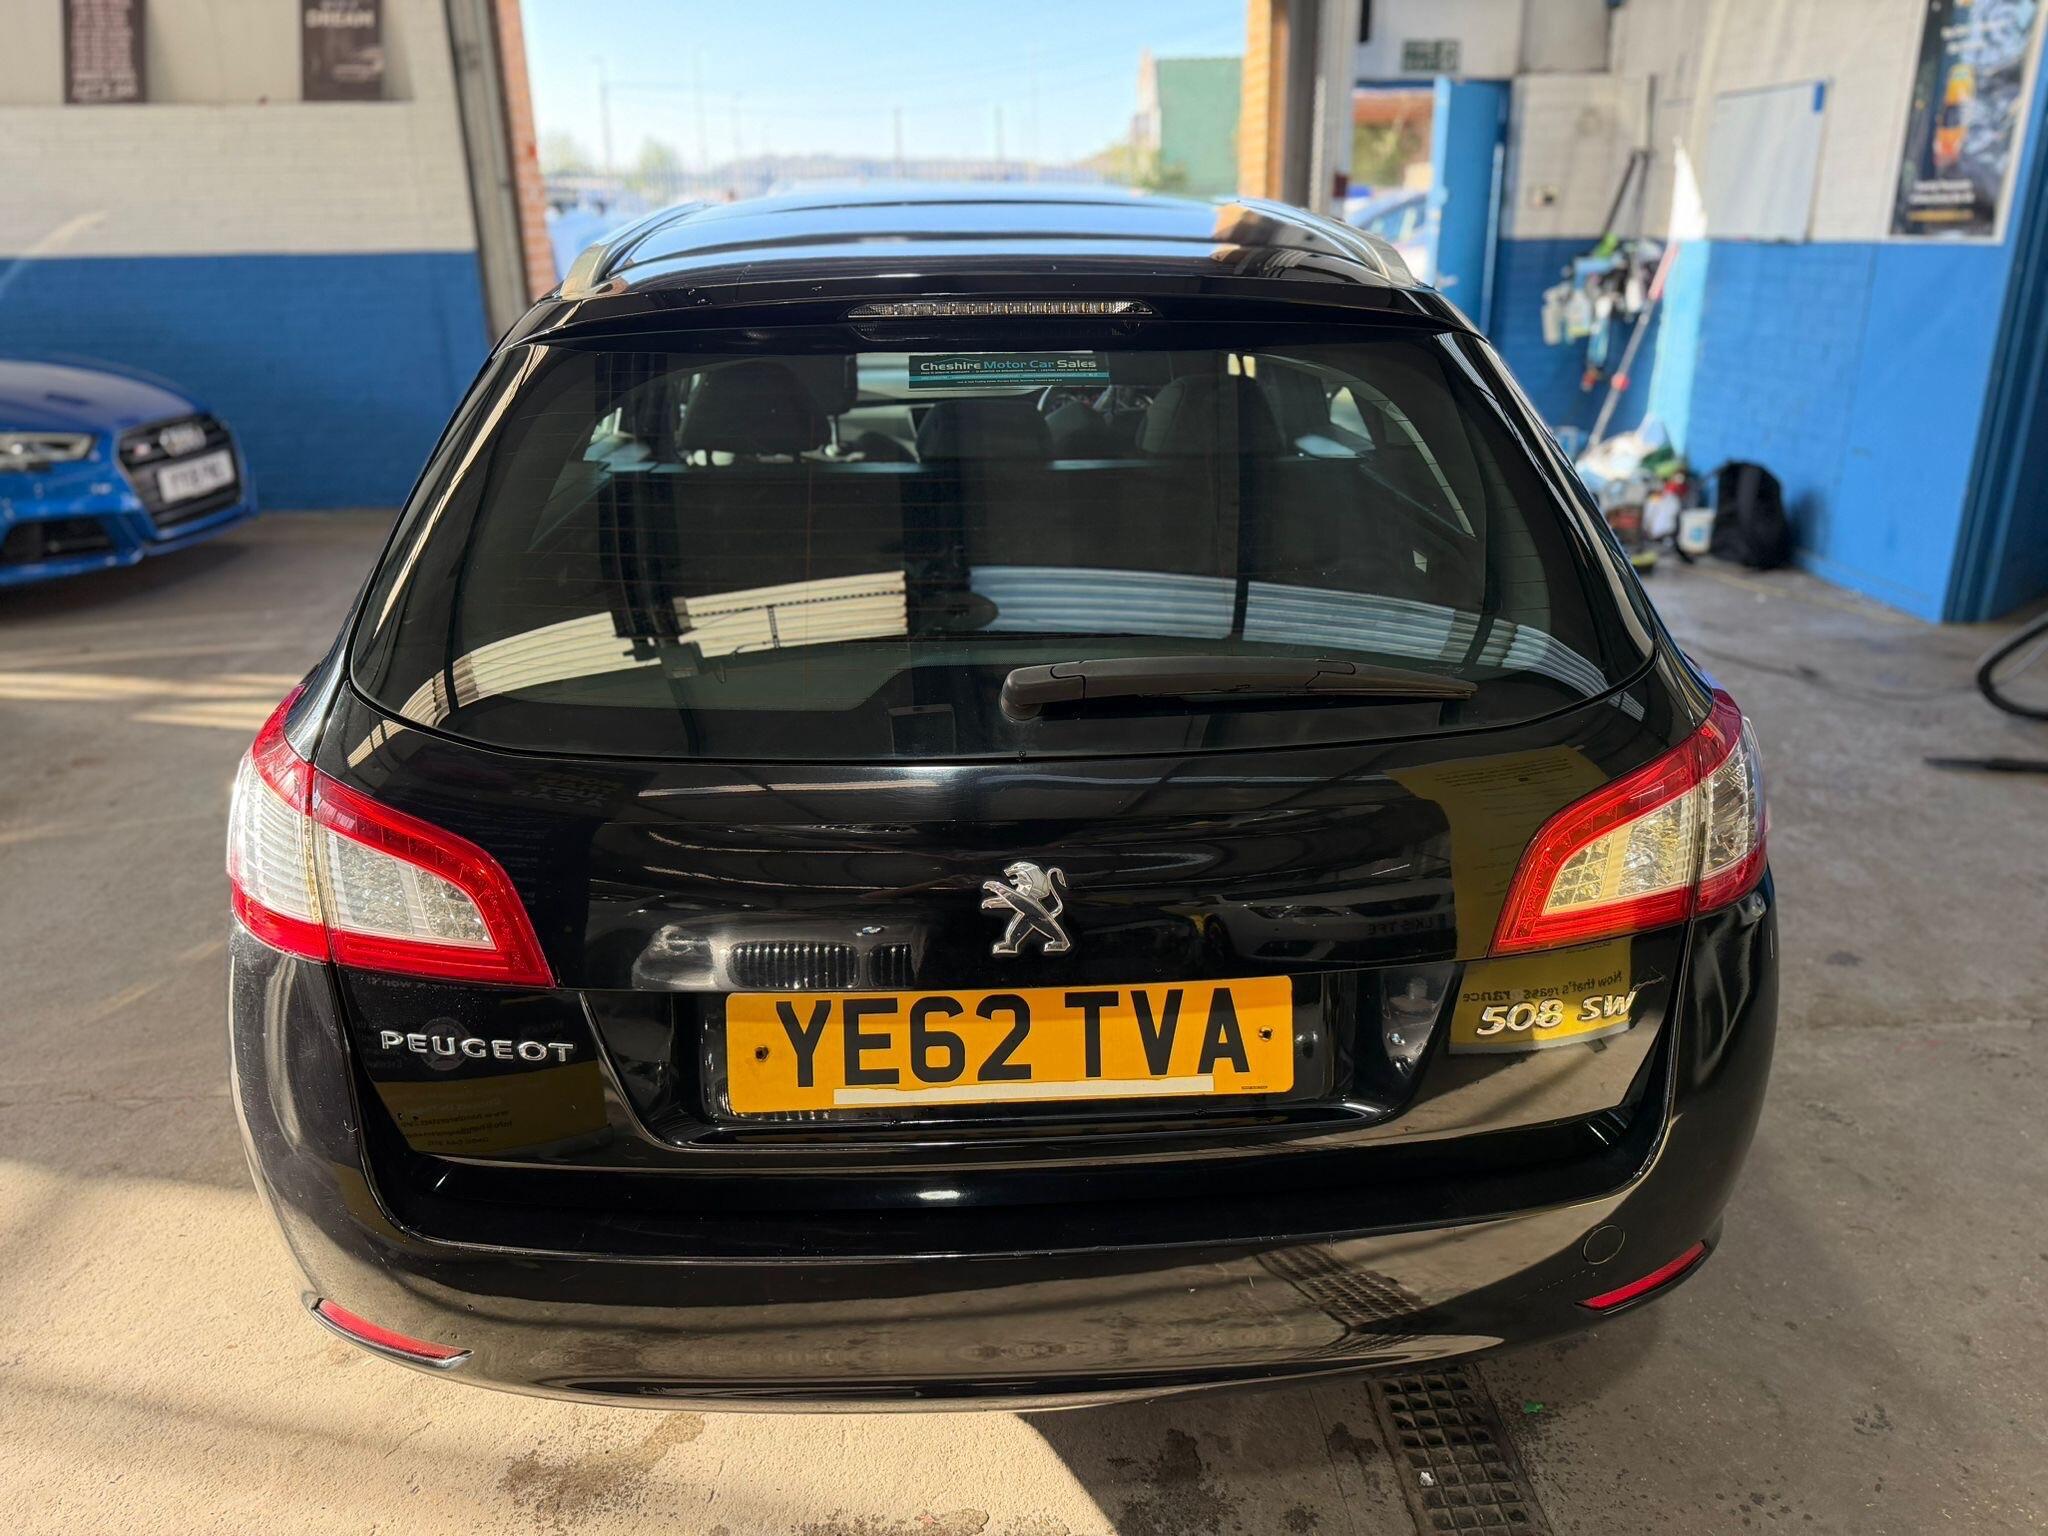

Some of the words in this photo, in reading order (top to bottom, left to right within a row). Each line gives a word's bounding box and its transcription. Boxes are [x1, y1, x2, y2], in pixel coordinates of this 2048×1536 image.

[920, 361, 981, 371] Cheshire
[983, 359, 1027, 370] Motor
[1029, 359, 1055, 369] Car
[1056, 358, 1096, 368] Sales
[1476, 998, 1564, 1036] 508
[1577, 990, 1637, 1021] SW
[380, 1030, 574, 1062] PEUGEOT
[775, 993, 1032, 1088] YE62
[1064, 987, 1250, 1078] TVA
